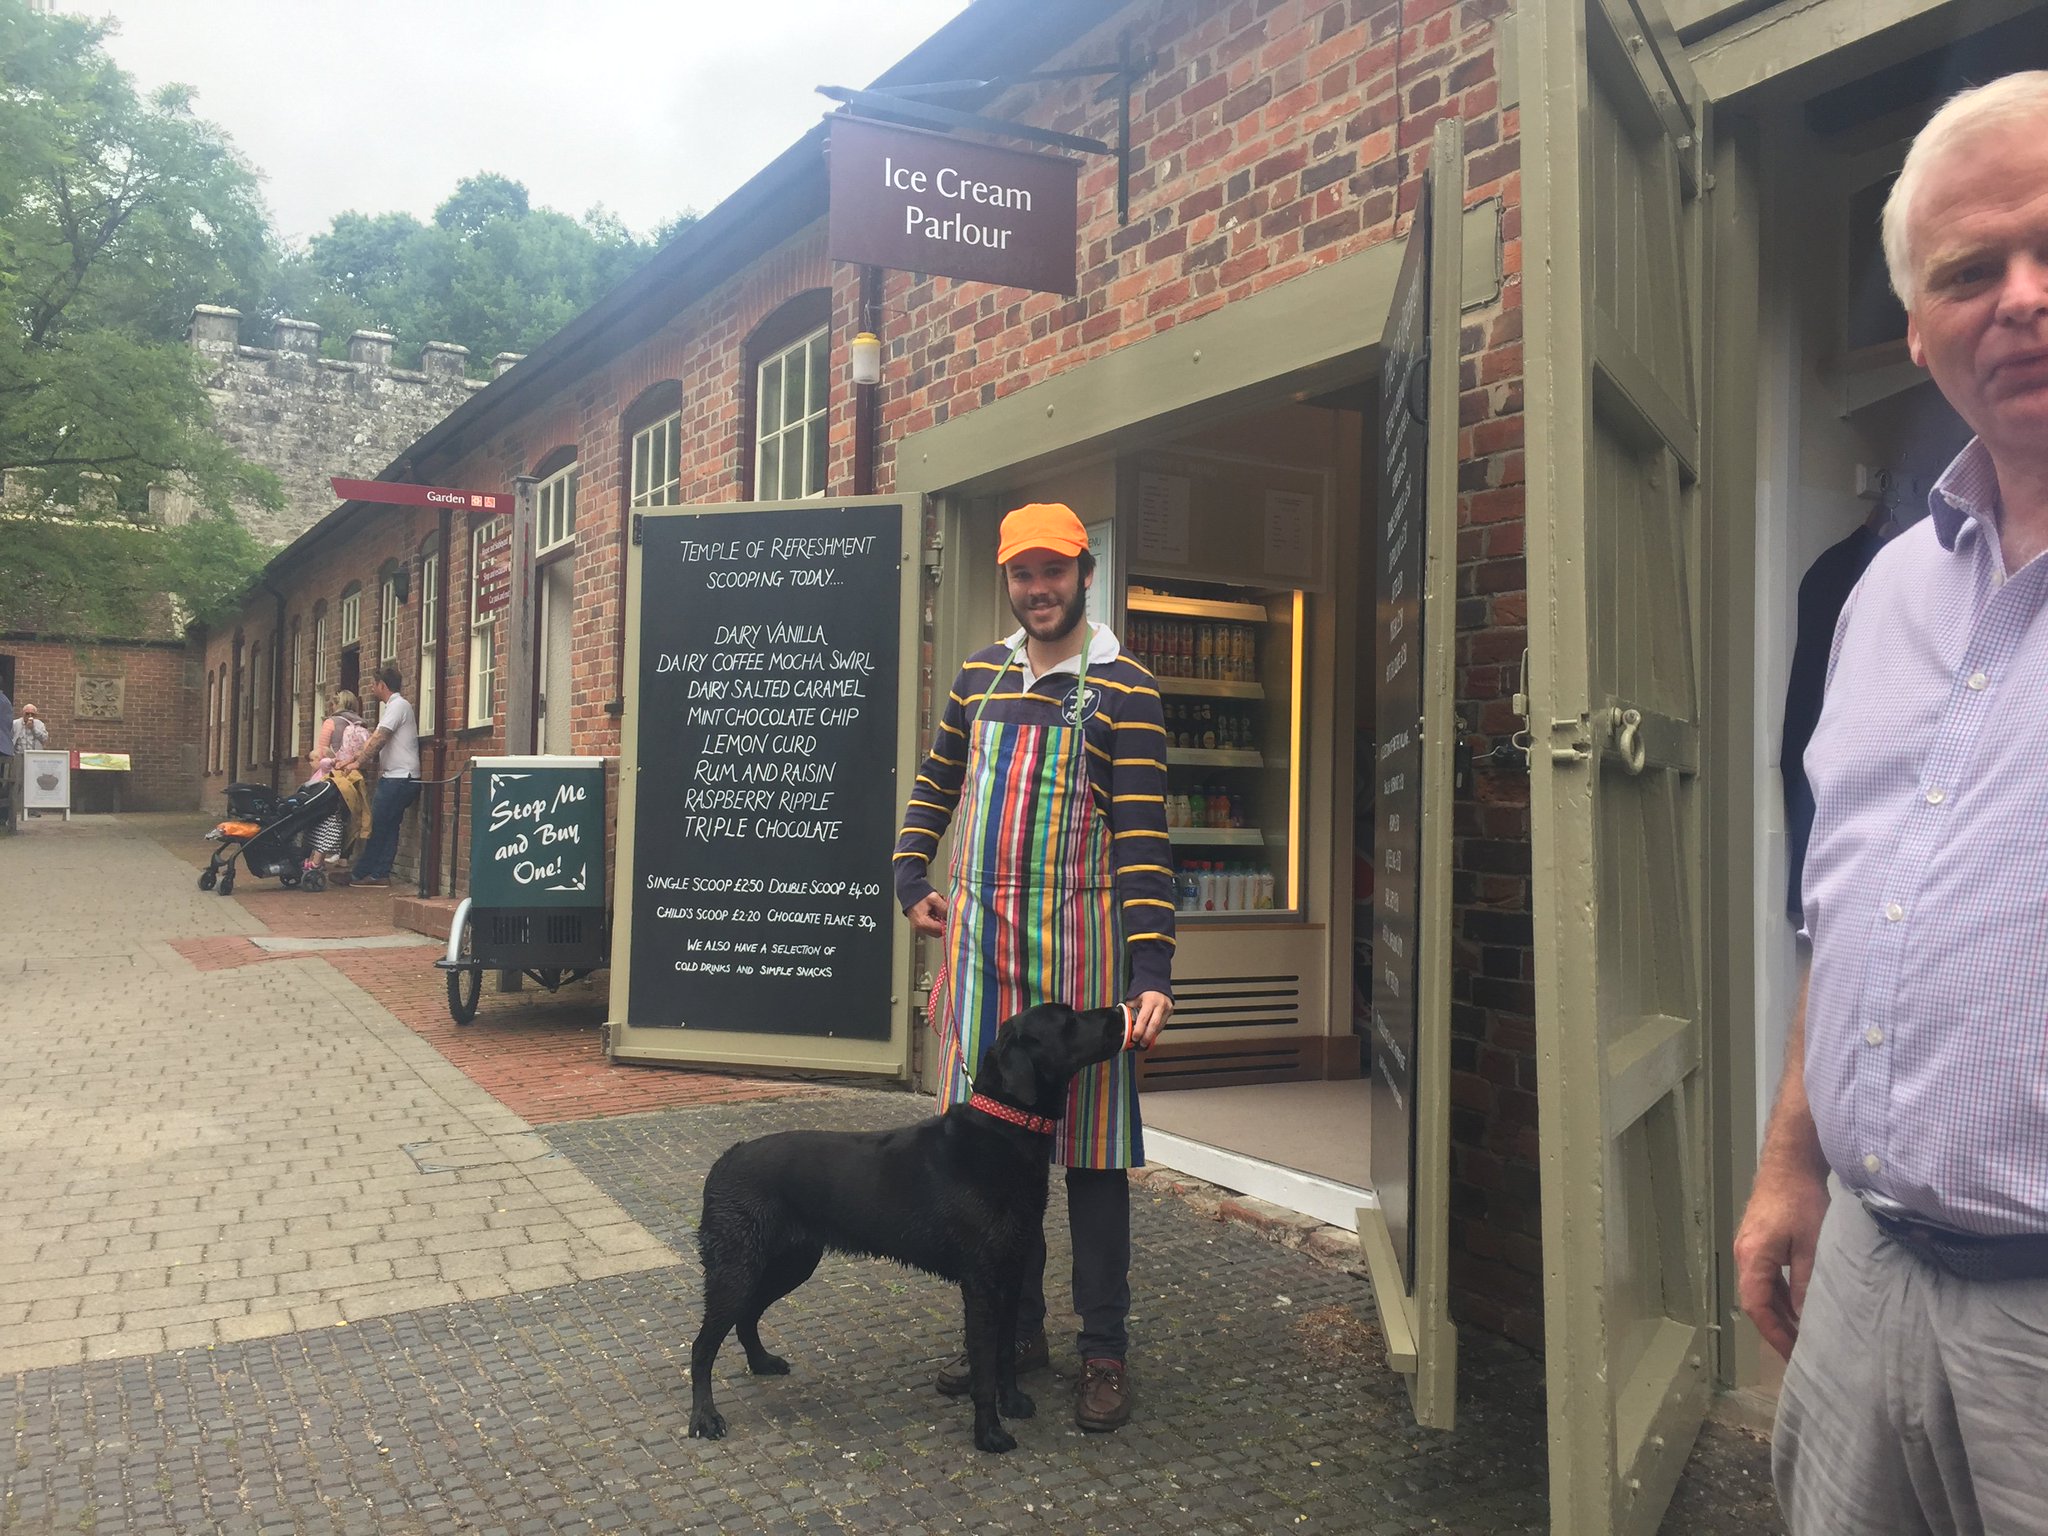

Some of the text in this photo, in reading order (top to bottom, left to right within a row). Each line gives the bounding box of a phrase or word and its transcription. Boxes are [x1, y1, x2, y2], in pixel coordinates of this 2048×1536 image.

[886, 158, 1030, 212] Ice Cream
[907, 205, 1011, 249] Parlour
[427, 491, 464, 503] Garden
[681, 536, 876, 562] TEMPLE OF REFRESHMENT
[707, 571, 784, 589] SCOOPING
[714, 621, 828, 649] DAIRY VANILLA
[656, 650, 874, 675] DAIRY COFFEE MOCHA SWIRL
[688, 679, 865, 700] DAIRY SALTED CARAMEL
[687, 707, 859, 726] MINT CHOCOLATE CHIP
[702, 734, 816, 756] LEMON CURD
[694, 760, 836, 786] RUM AND RAISIN
[489, 785, 586, 832] Stop Me
[685, 789, 834, 813] RASPBERRY RIPPLE
[686, 816, 842, 842] TRIPLE CHOCOLATE
[495, 822, 580, 861] and Buy
[514, 855, 562, 885] One!
[647, 875, 689, 889] SINGLE
[692, 878, 734, 892] SCOOP
[768, 879, 809, 894] DOUBLE
[809, 880, 845, 895] SCOOP
[696, 908, 728, 920] SCOOP
[768, 909, 821, 924] CHOCOLATE
[824, 914, 855, 926] FLAKE
[858, 915, 876, 932] 30p
[688, 939, 836, 955] WE ALSO HAVE A SELECTION OF
[675, 961, 832, 977] COLD DRINKS AND SIMPLE SNACKS
